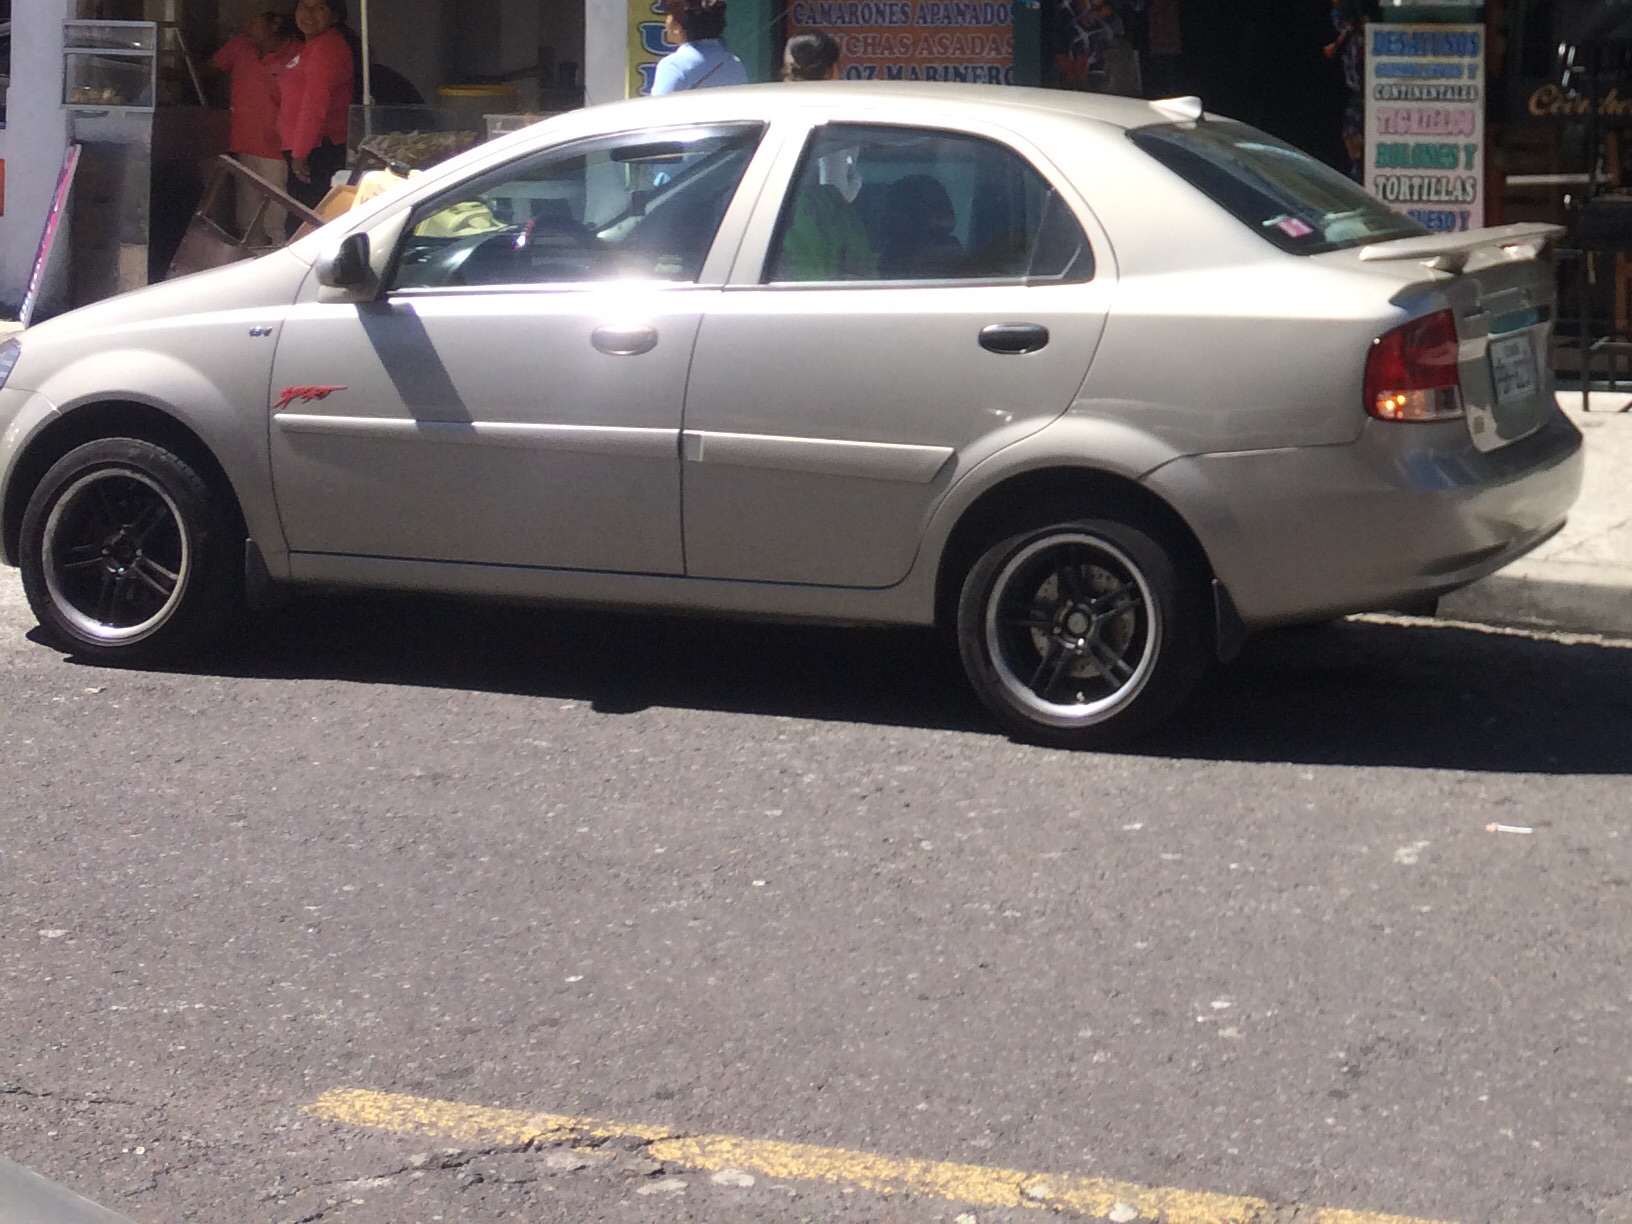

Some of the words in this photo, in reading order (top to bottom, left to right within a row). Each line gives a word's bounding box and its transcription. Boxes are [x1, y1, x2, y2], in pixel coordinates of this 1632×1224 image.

[793, 1, 912, 27] CAMARONES
[915, 1, 1013, 26] APANADO
[1373, 175, 1477, 204] TORTILLAS
